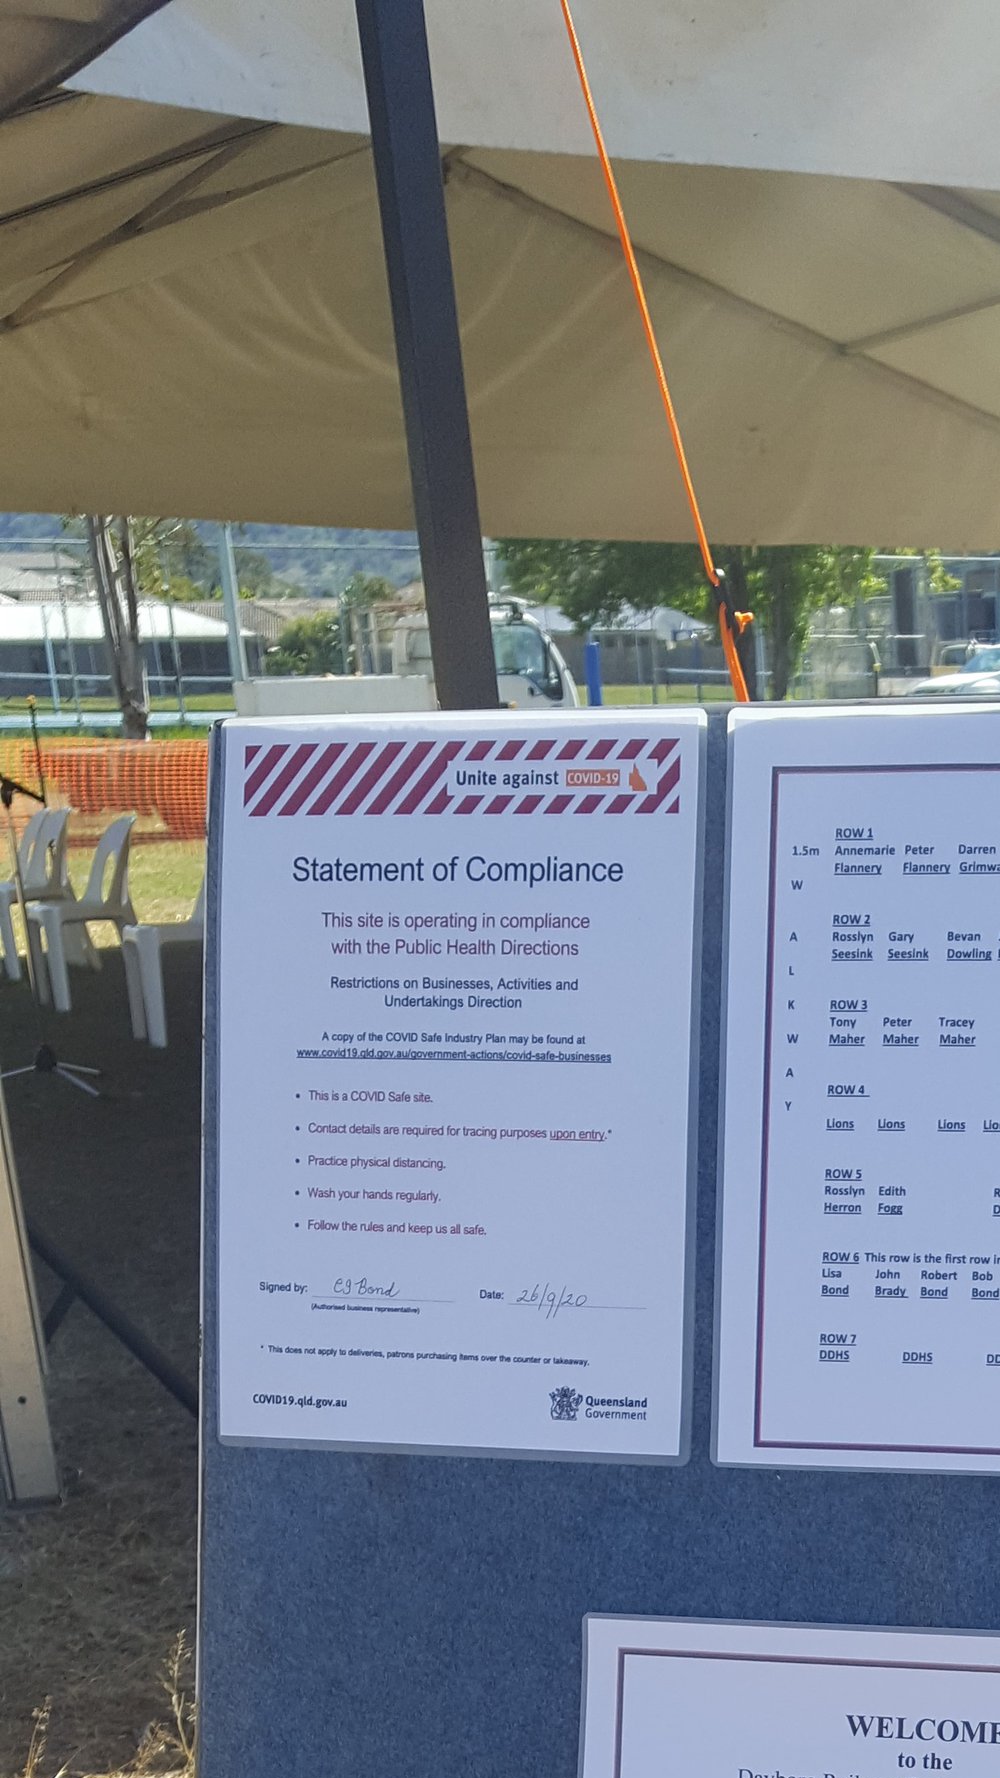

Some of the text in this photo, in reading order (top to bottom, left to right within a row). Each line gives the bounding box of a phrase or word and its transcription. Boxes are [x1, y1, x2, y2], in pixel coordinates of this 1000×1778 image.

[457, 770, 619, 788] Unite against COVID-19
[835, 827, 874, 841] ROW 1
[792, 846, 819, 856] 1.5m
[835, 845, 895, 855] Annemarie
[905, 845, 934, 855] Peter
[959, 844, 996, 854] Darren
[293, 856, 623, 888] Statement of Compliance
[834, 863, 882, 875] Flannery
[903, 862, 950, 875] Flannery
[322, 912, 590, 932] This site is operating in compliance
[833, 914, 871, 927] ROW 2
[833, 931, 873, 944] Rosslyn
[889, 932, 914, 943] Gary
[947, 932, 981, 941] Bevan
[331, 939, 578, 955] with the Public Health Directions
[832, 948, 873, 961] Seesink
[888, 948, 928, 961] Seesink
[947, 948, 992, 961] Dowling
[822, 1251, 850, 1265] ROW
[853, 1251, 859, 1265] 6
[864, 1253, 886, 1262] This
[913, 1253, 921, 1263] is
[924, 1253, 941, 1263] the
[945, 1254, 966, 1264] first
[260, 1282, 307, 1294] Signed by:
[355, 1279, 400, 1298] Bond
[480, 1290, 504, 1299] Date:
[516, 1282, 588, 1320] 26/9/20
[820, 1333, 857, 1346] ROW 7
[819, 1350, 849, 1362] DDHS
[902, 1352, 932, 1364] DDHS
[253, 1394, 347, 1408] COVID19.qld.gov.au
[586, 1396, 647, 1413] Queensland
[585, 1408, 646, 1420] Government
[898, 1753, 952, 1770] to the
